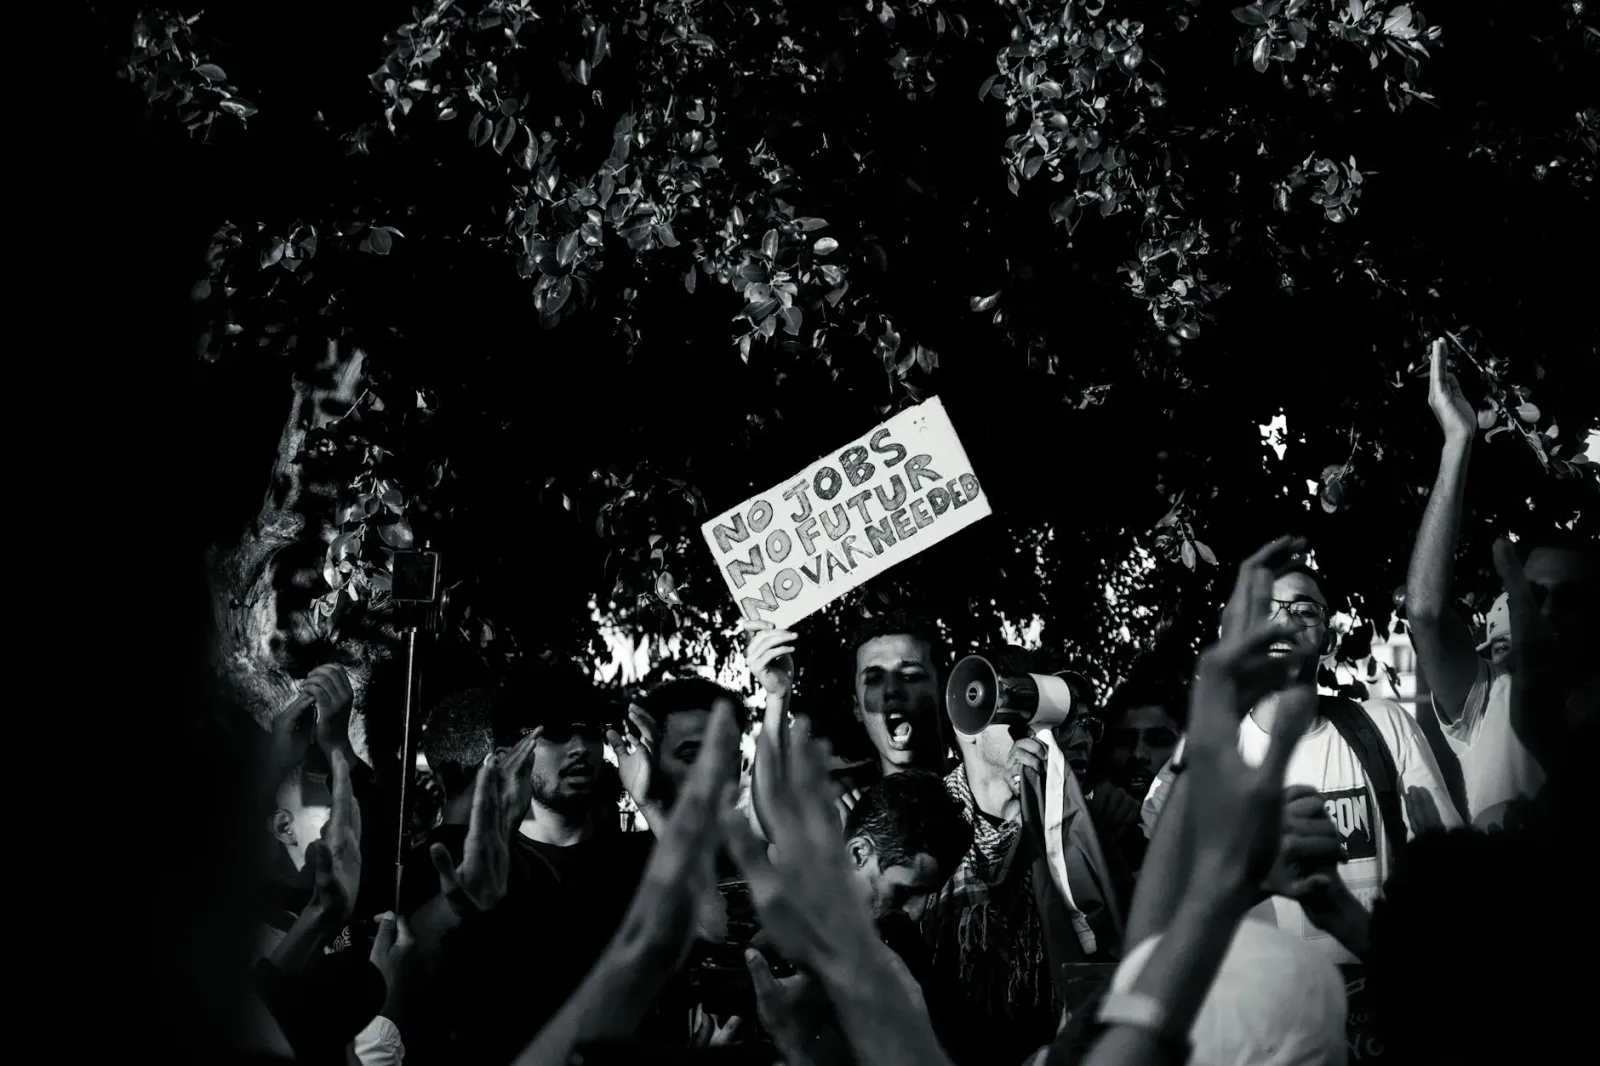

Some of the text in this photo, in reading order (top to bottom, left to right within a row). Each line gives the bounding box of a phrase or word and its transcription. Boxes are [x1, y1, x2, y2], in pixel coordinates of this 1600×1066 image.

[712, 428, 907, 553] NO JOBS
[726, 454, 943, 589] NO FUTUR
[740, 567, 803, 621] NO
[865, 473, 980, 555] NEEDED
